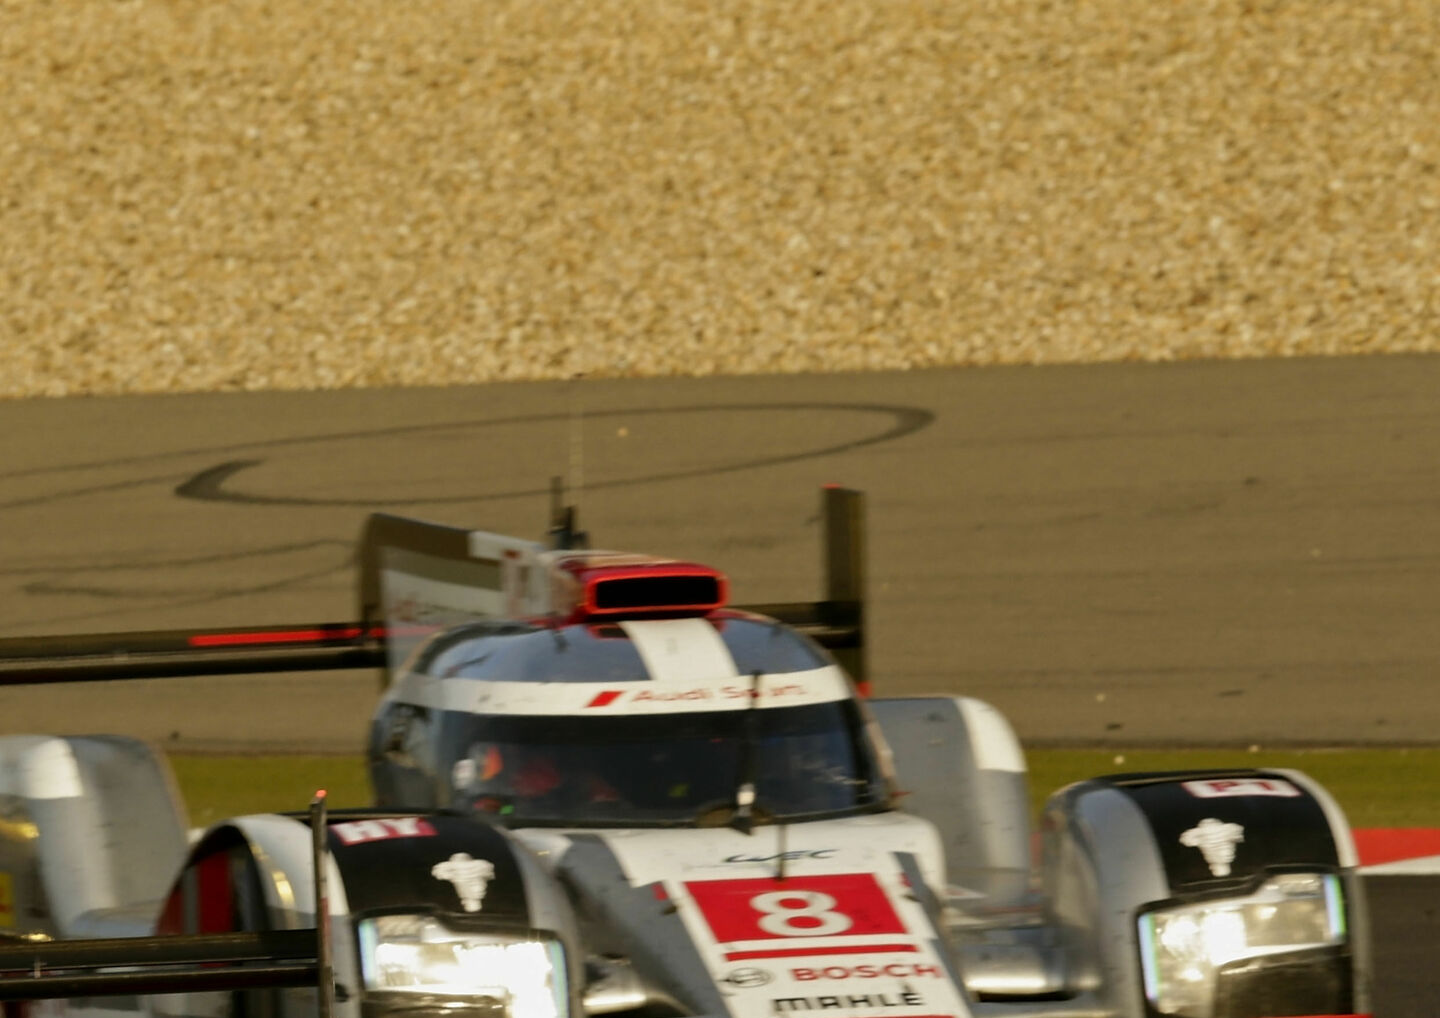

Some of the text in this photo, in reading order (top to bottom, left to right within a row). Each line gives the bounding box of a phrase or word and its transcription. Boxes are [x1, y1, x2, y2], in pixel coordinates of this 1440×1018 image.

[749, 890, 852, 937] 8
[789, 963, 943, 981] BOSCH
[772, 993, 923, 1012] MAHLE
